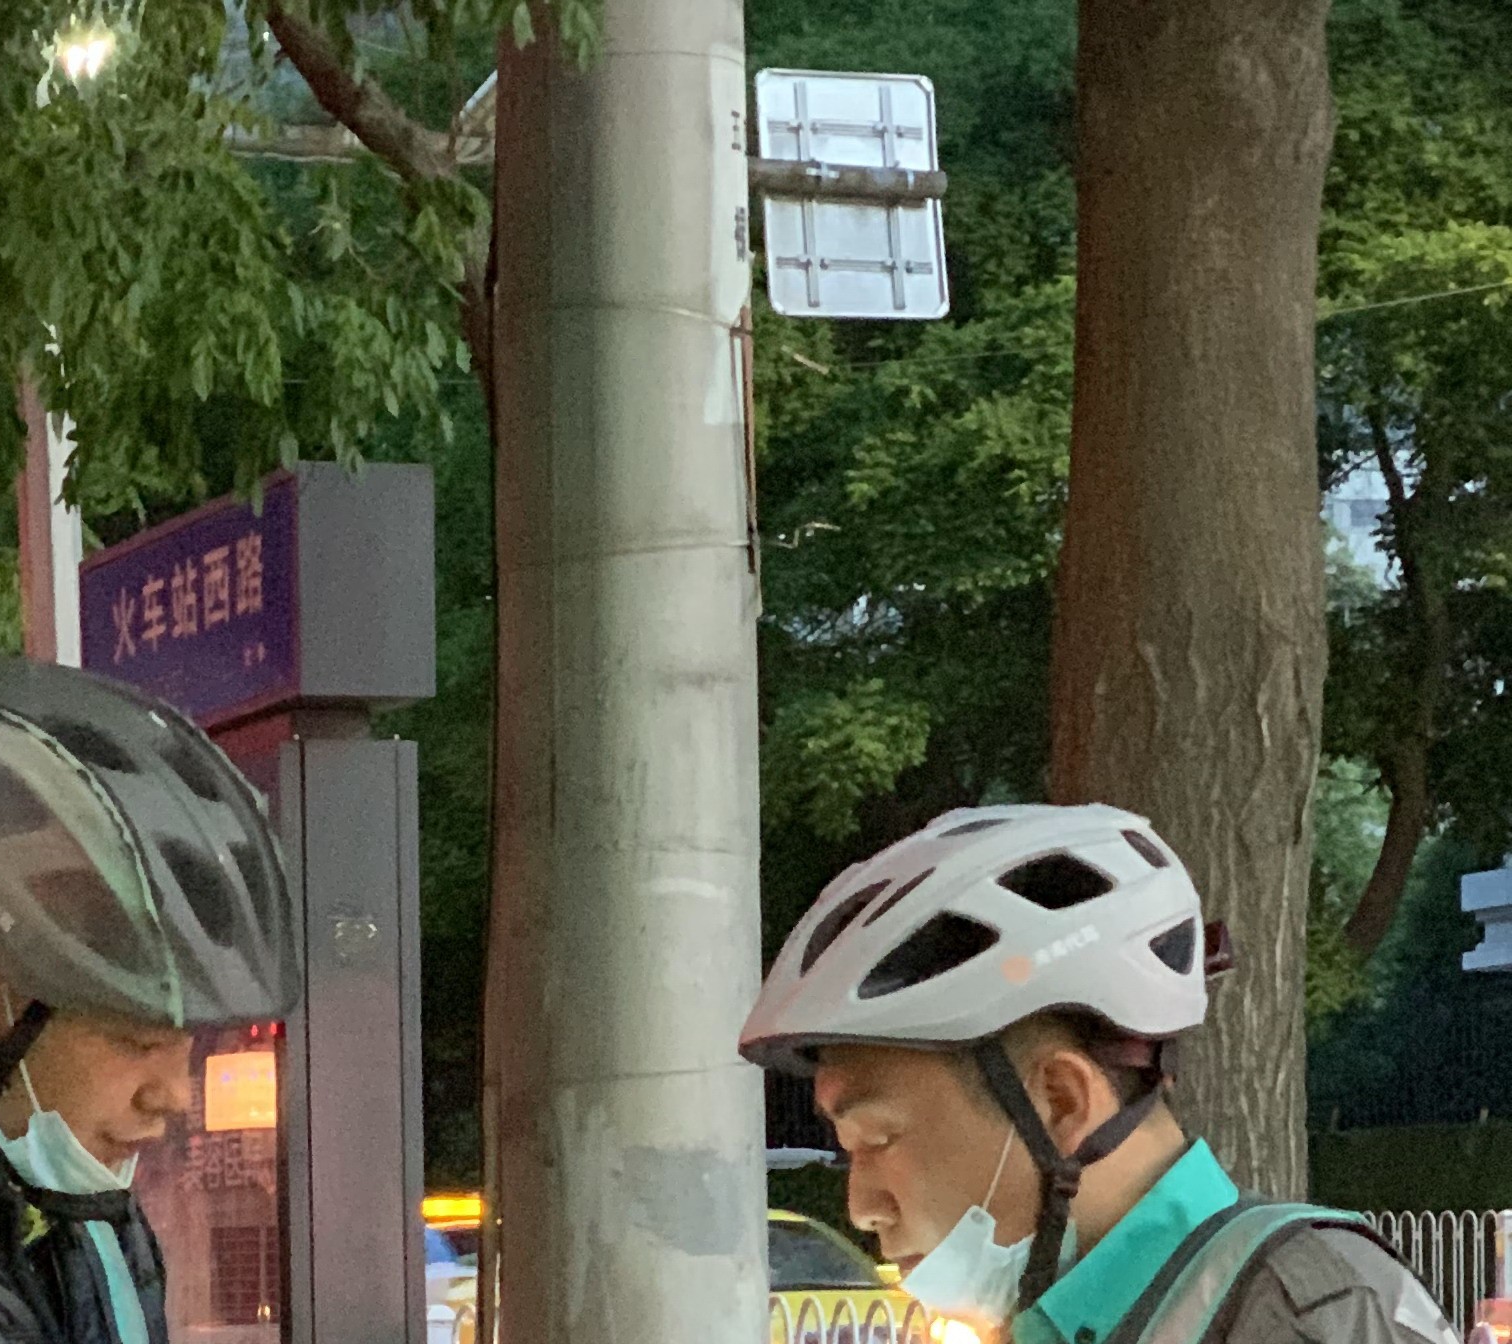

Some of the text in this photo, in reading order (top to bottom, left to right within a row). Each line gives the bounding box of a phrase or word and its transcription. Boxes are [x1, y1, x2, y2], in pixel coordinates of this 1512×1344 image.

[113, 529, 264, 666] 火车站西路
